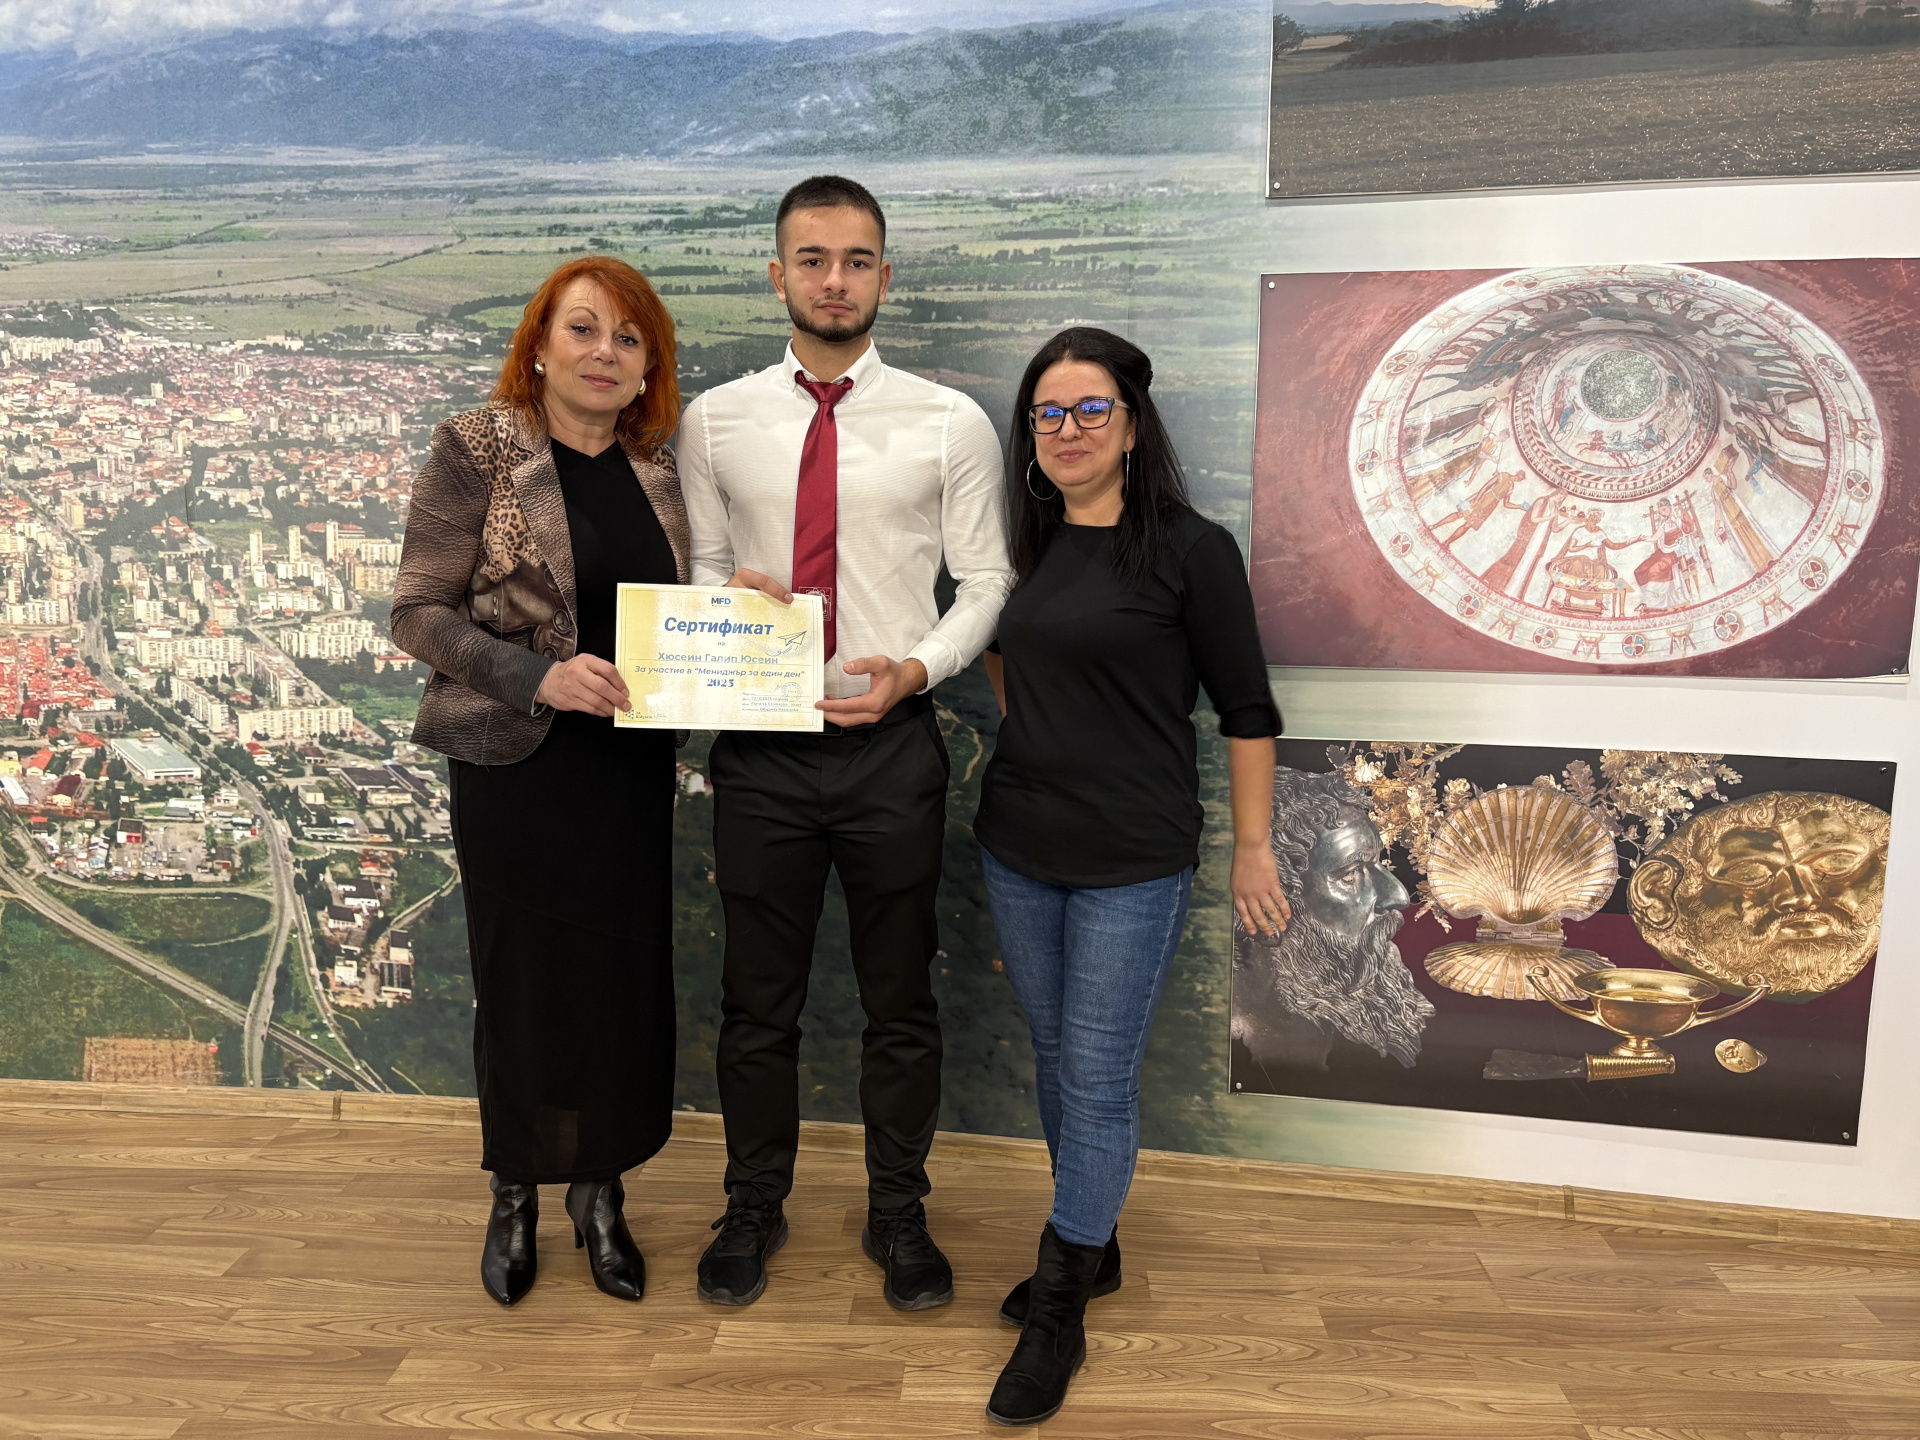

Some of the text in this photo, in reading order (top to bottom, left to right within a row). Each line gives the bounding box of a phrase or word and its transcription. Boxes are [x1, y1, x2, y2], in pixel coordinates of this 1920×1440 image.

[711, 597, 731, 605] MFD
[664, 617, 774, 637] Сертификат
[658, 652, 778, 664] Хюсеин Галип Юсеин
[634, 665, 646, 673] За
[706, 678, 734, 687] 2025
